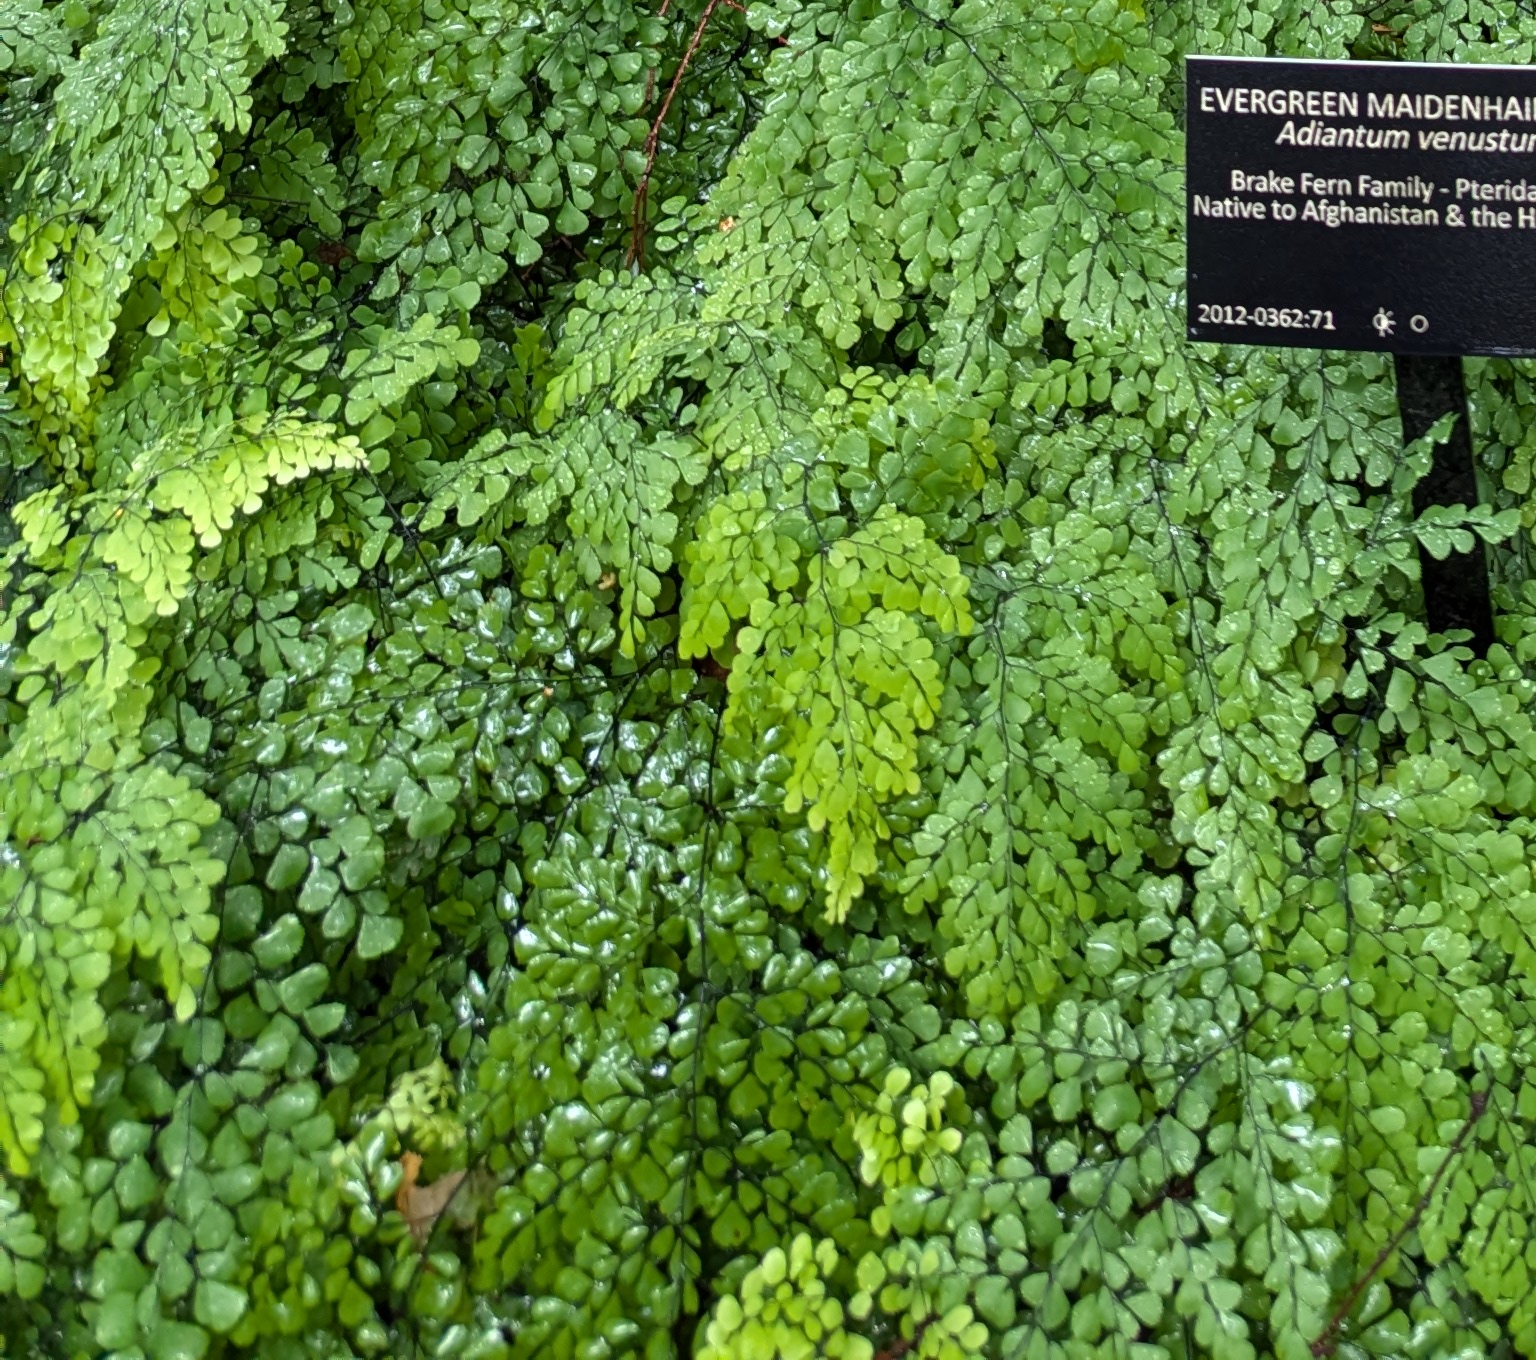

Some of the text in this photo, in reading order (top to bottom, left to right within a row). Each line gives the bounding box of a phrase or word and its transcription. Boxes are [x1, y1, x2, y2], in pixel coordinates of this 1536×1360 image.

[1200, 87, 1358, 117] EVERGREEN
[1275, 121, 1410, 149] Adiantum
[1231, 171, 1294, 193] Brake
[1300, 173, 1352, 196] Fern
[1359, 176, 1434, 203] Family
[1193, 195, 1265, 220] Native
[1272, 202, 1296, 221] to
[1302, 202, 1439, 227] Afghanistan
[1445, 205, 1465, 227] &
[1472, 207, 1511, 228] the
[1197, 305, 1334, 330] 2012-0362:71
